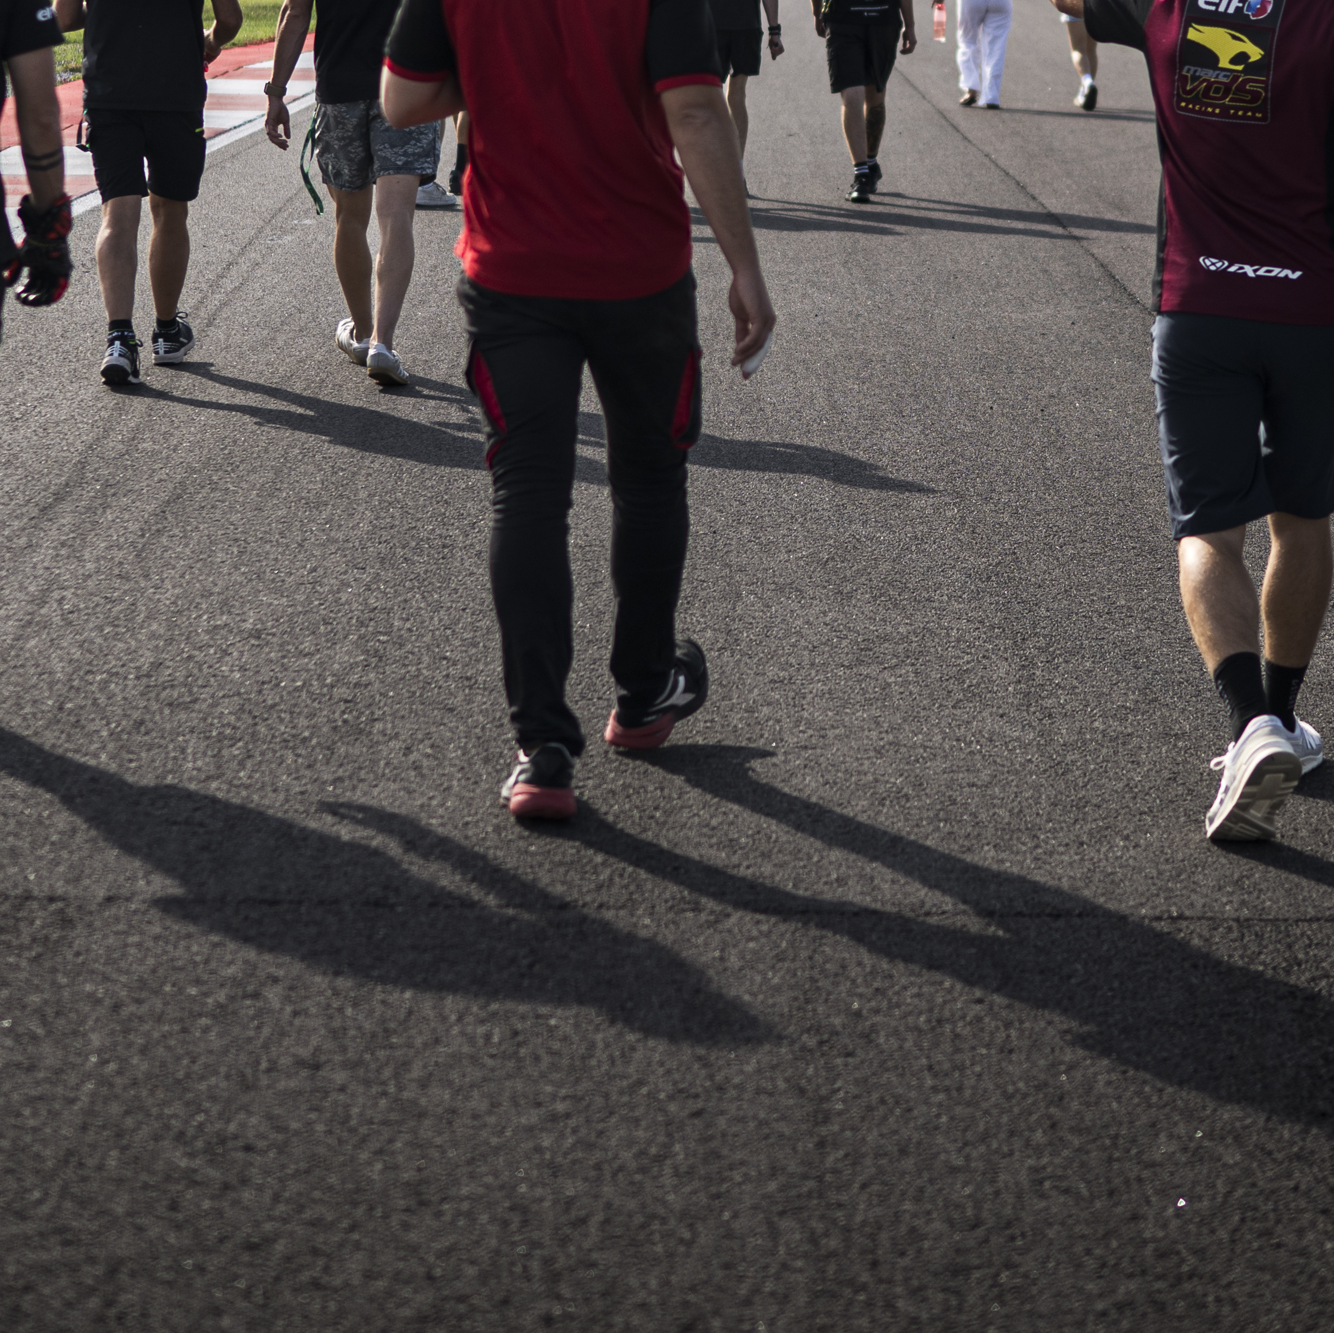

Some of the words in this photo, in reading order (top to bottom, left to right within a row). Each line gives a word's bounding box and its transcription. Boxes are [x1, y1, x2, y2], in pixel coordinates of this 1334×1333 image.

[1183, 66, 1231, 80] marc
[1179, 101, 1220, 114] RACING
[1229, 109, 1262, 118] TEAM
